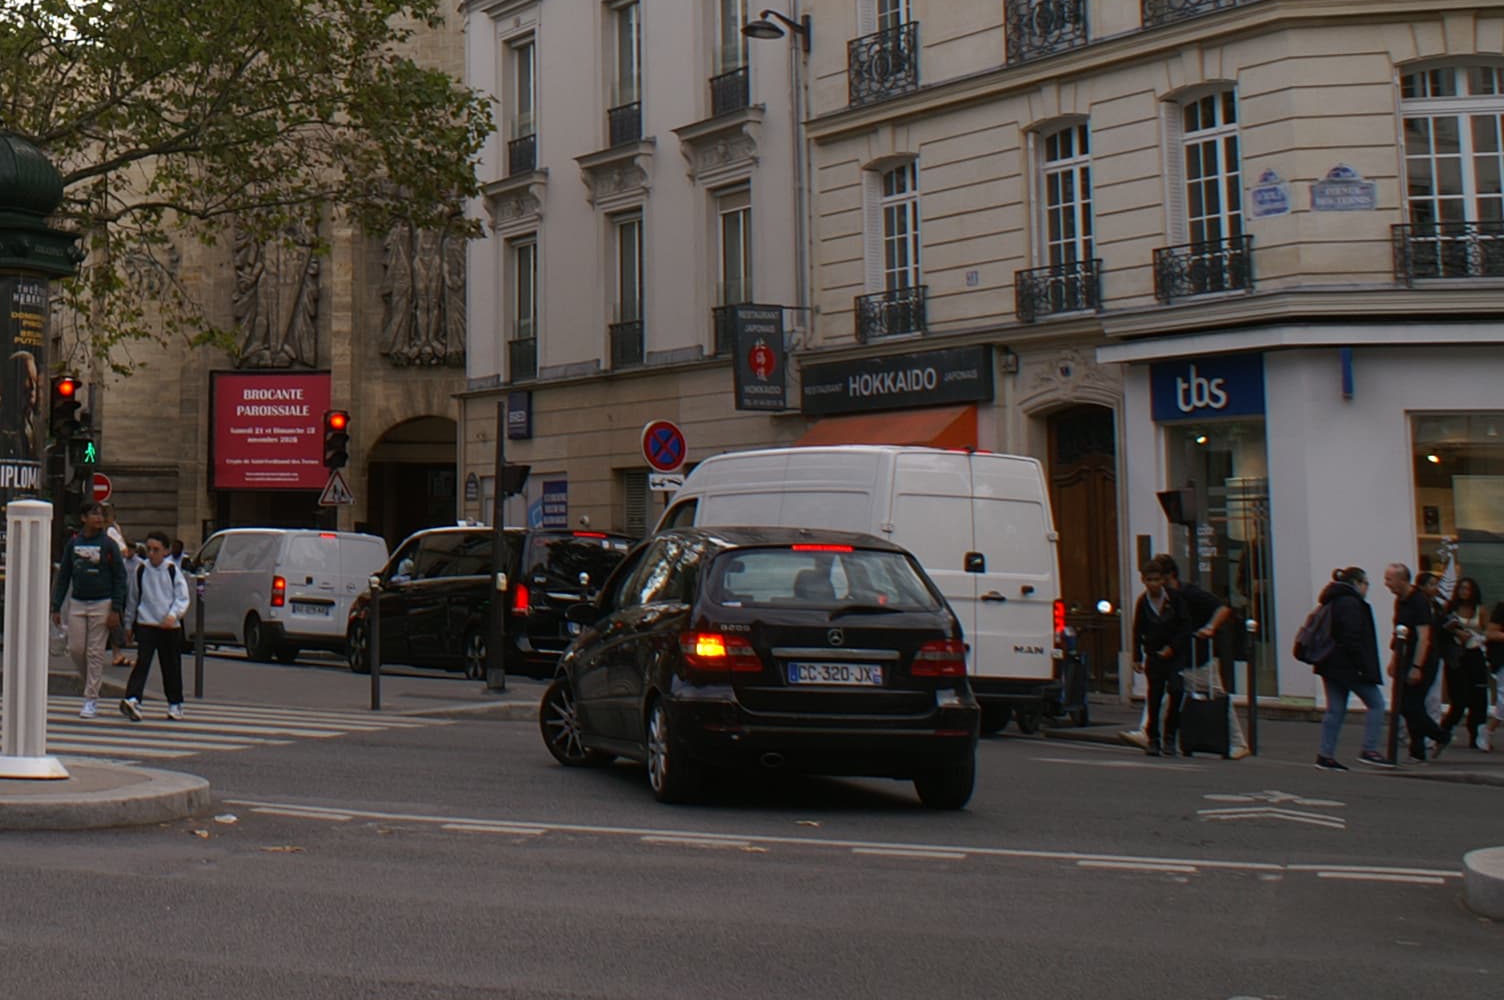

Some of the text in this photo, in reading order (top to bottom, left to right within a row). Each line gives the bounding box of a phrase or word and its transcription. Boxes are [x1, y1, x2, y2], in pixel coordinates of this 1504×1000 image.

[849, 368, 937, 397] HOKKAIDO
[1176, 364, 1227, 412] tbs
[243, 389, 304, 400] BROCANTE
[236, 405, 310, 416] PAROISSIALE
[1014, 646, 1044, 655] MAN
[799, 665, 872, 682] CC-320-JX
